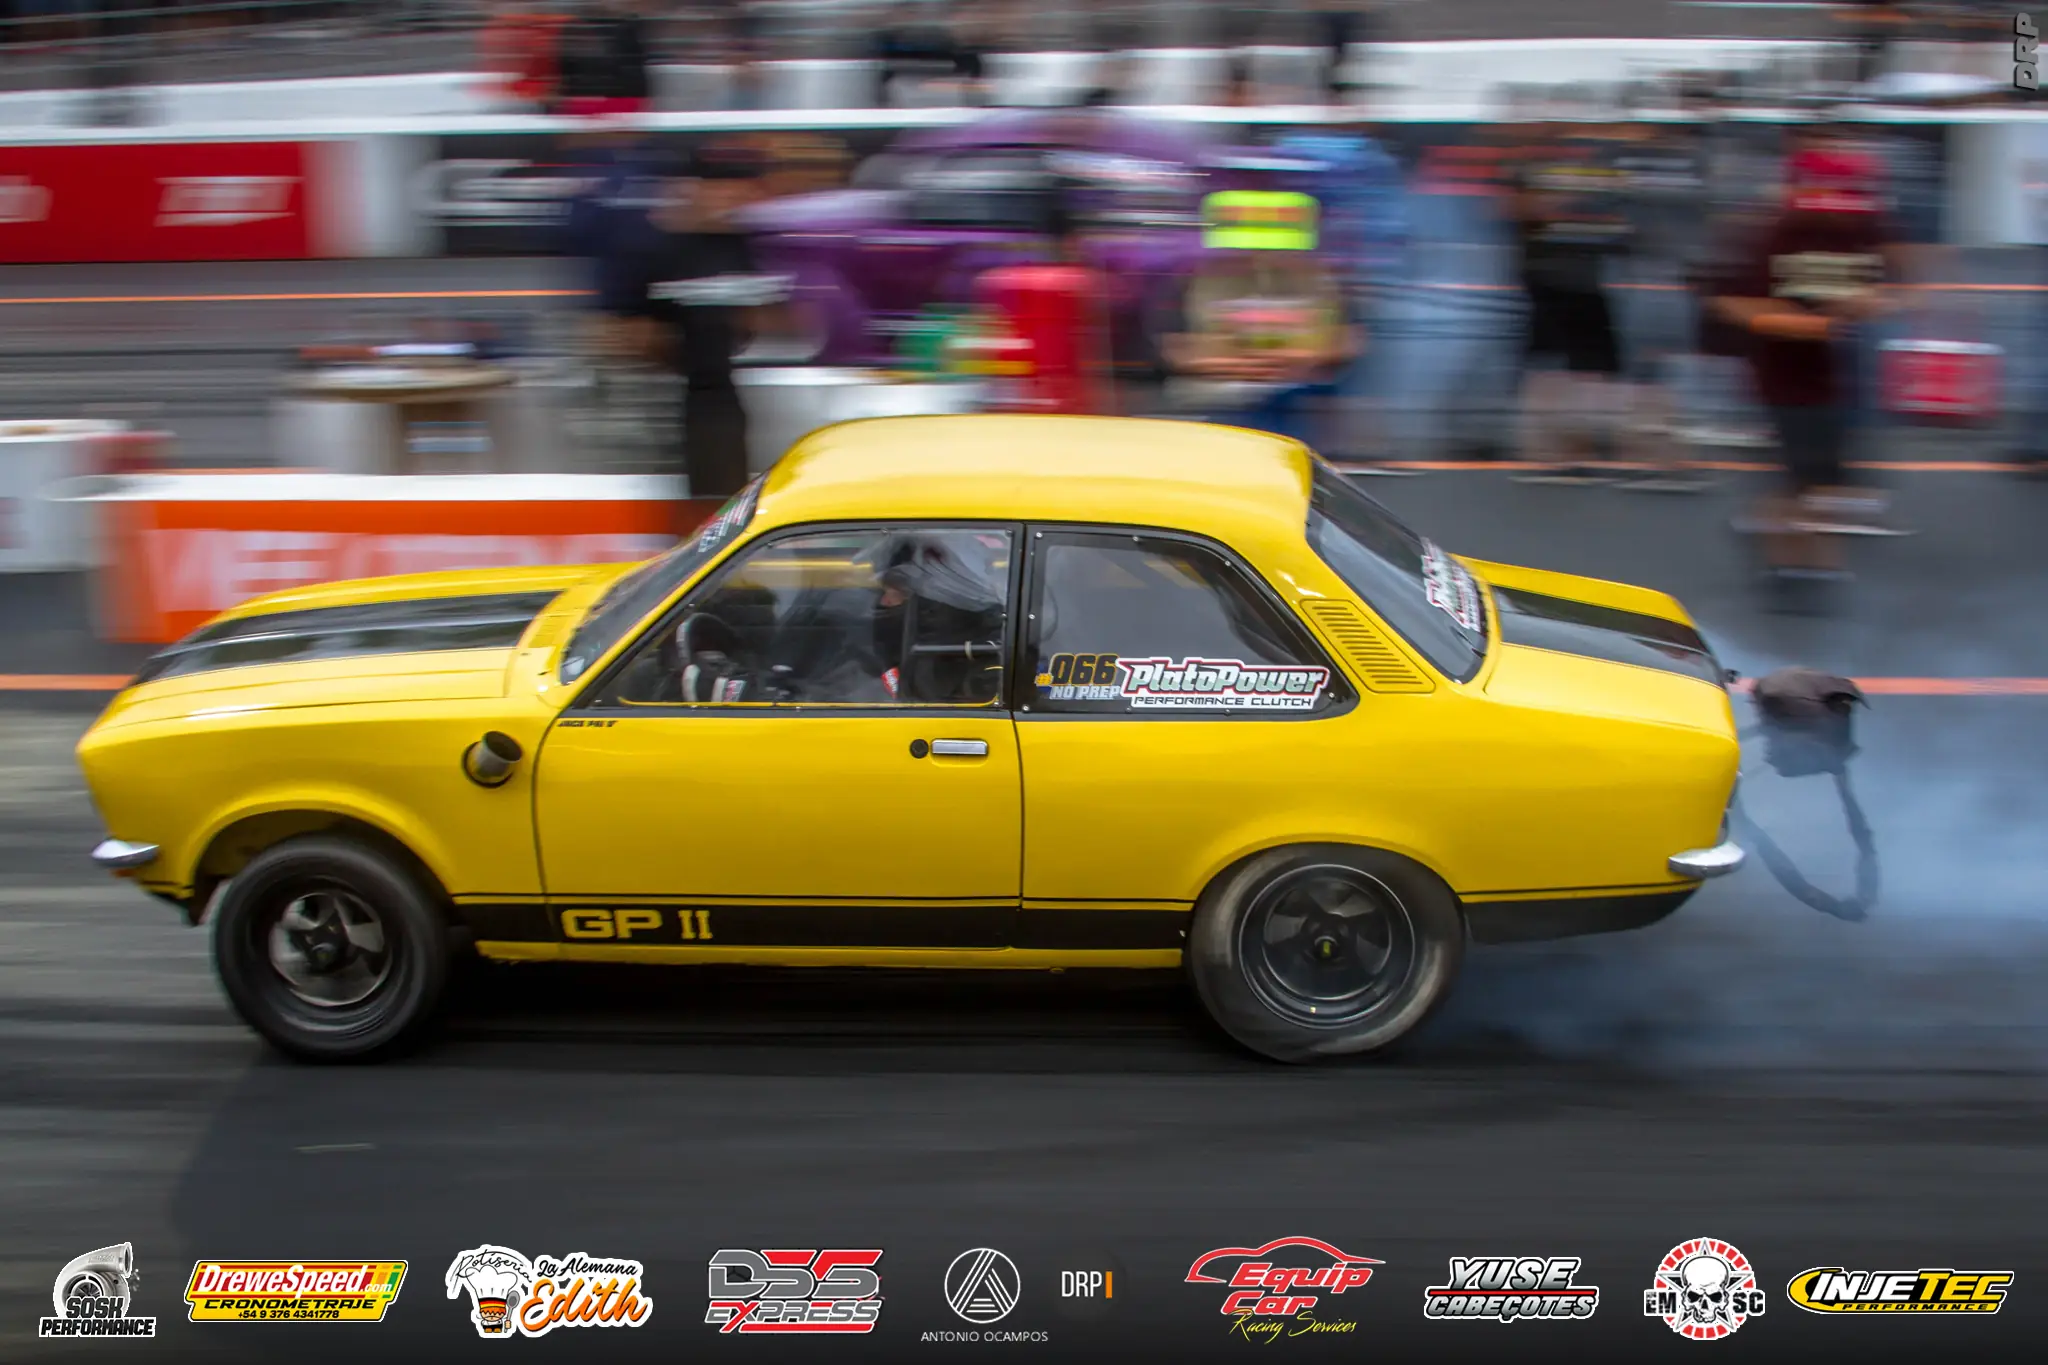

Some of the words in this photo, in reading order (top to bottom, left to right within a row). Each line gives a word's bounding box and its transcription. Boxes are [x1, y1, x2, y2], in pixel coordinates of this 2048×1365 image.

[1124, 660, 1326, 694] PlatoPower
[1050, 685, 1074, 699] NO
[1078, 685, 1119, 699] PREP
[1134, 696, 1244, 706] PERFORMANCE
[1251, 697, 1312, 707] CLUTCH
[561, 909, 663, 938] GP
[678, 910, 713, 939] II
